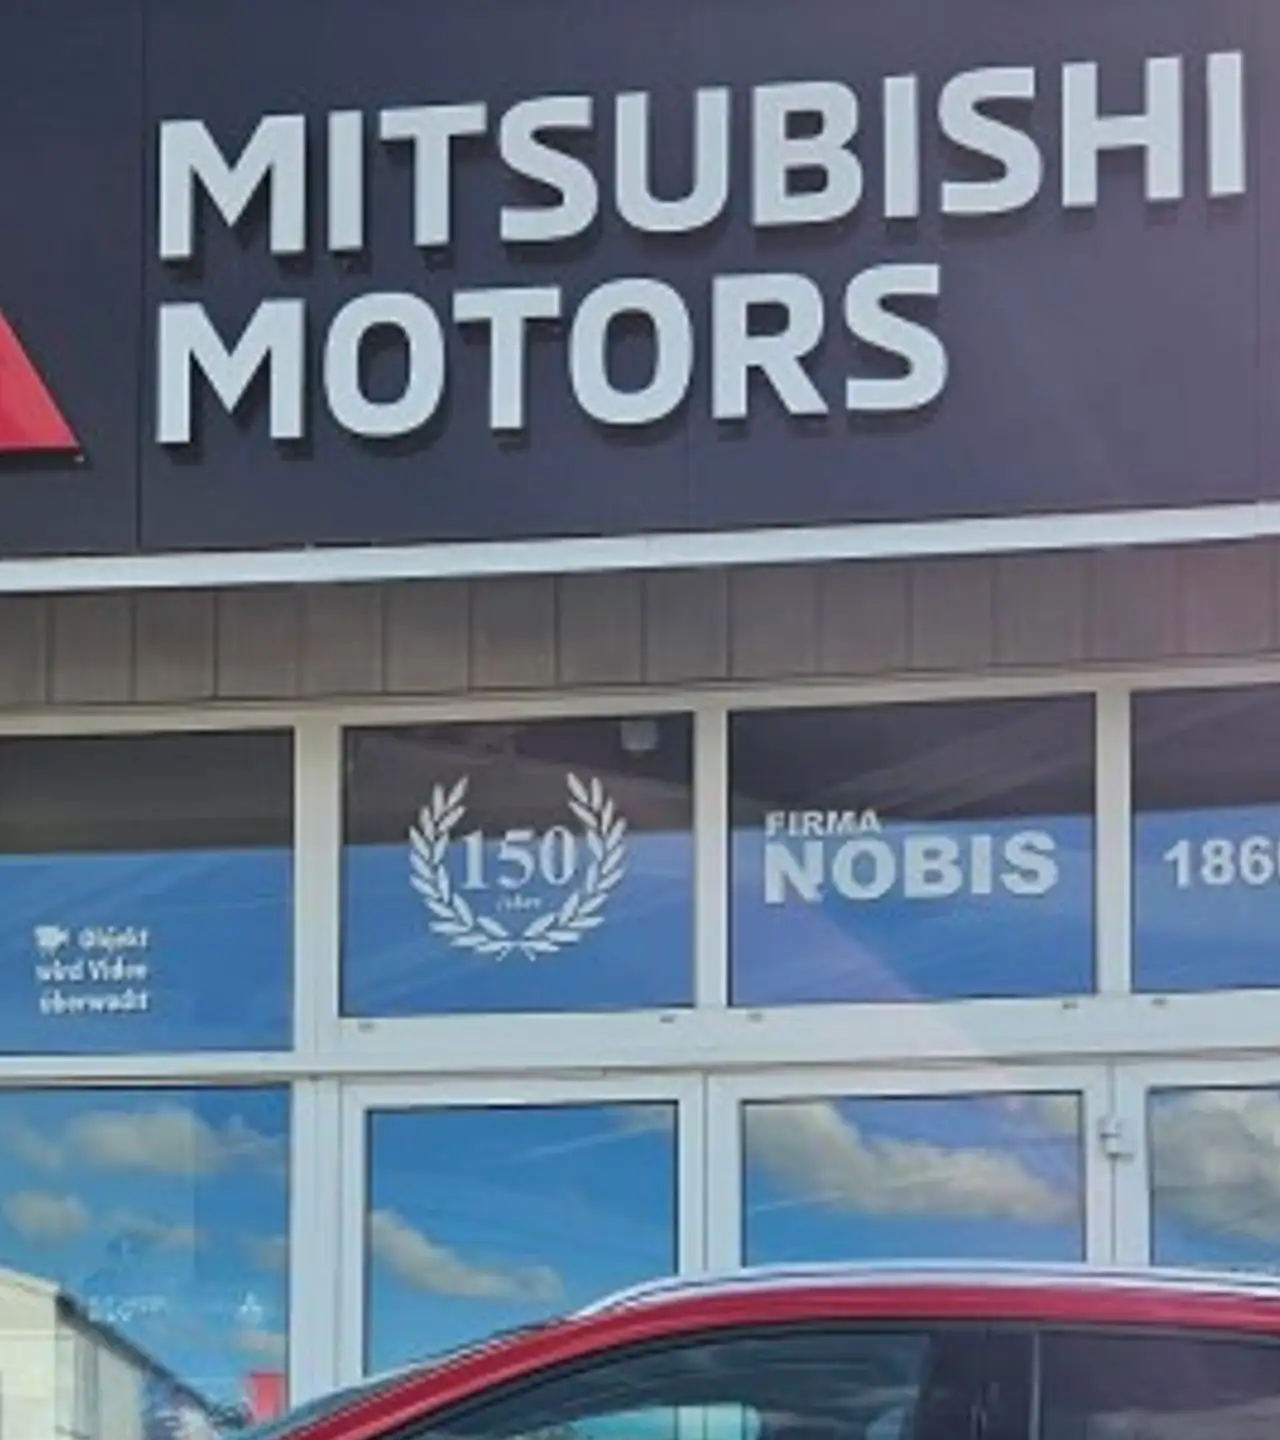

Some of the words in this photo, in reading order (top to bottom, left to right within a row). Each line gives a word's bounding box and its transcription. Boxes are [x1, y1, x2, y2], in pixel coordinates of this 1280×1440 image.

[157, 51, 1247, 260] MITSUBISHI
[155, 263, 950, 446] MOTORS
[459, 825, 576, 889] 150
[764, 810, 883, 837] FIRMA
[762, 831, 1060, 904] NOBIS
[35, 959, 83, 981] wird
[87, 957, 148, 981] Video
